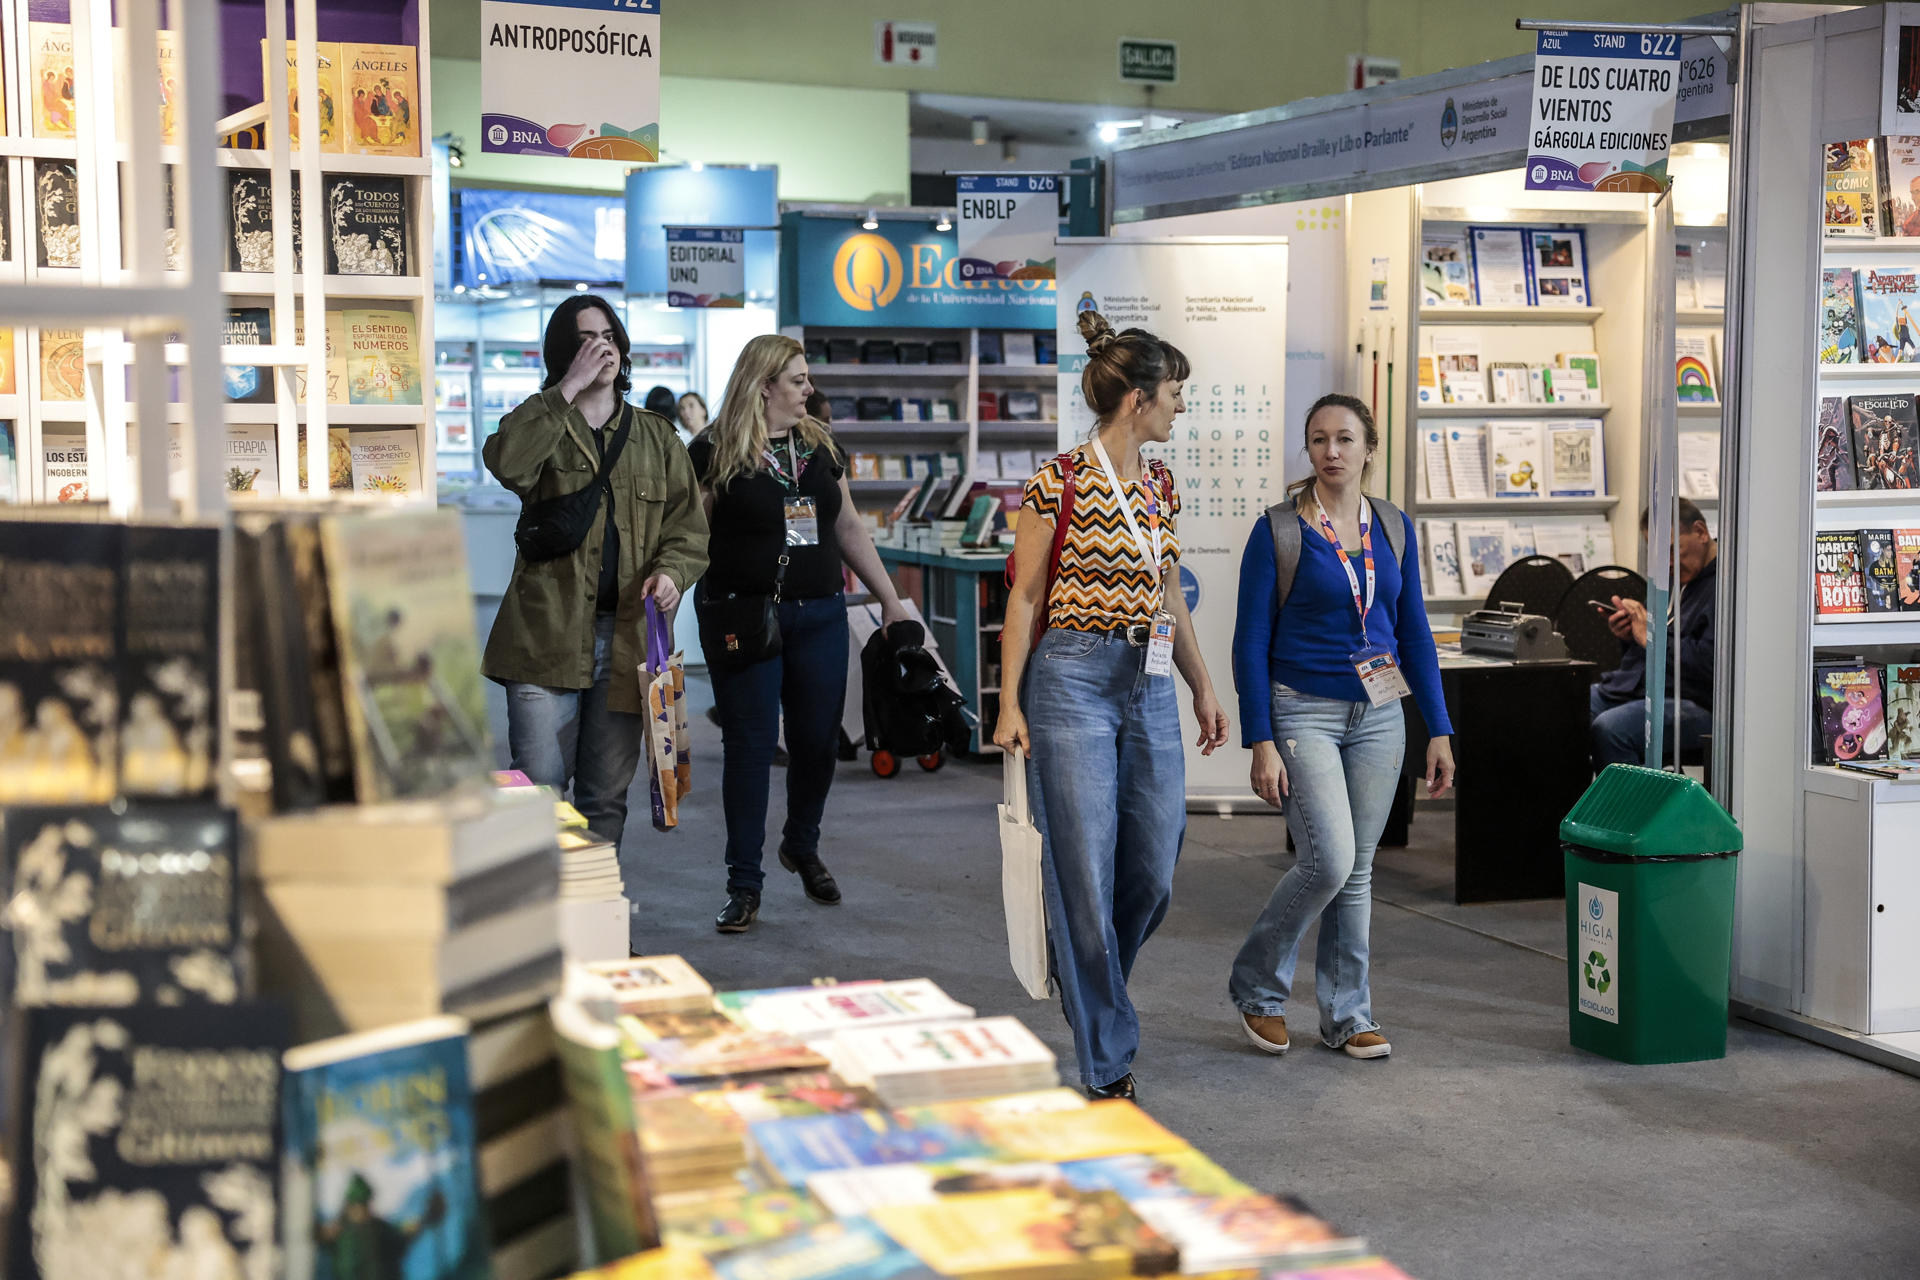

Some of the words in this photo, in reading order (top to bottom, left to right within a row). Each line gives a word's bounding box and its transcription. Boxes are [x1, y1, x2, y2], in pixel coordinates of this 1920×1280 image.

[489, 23, 652, 58] ANTROPOSÓFICA
[1542, 39, 1562, 49] AZUL
[1593, 34, 1625, 49] STAND
[1640, 33, 1675, 56] 622
[352, 58, 408, 72] ÁNGELES
[1541, 65, 1563, 88] DE
[1569, 67, 1600, 90] LOS
[1606, 68, 1671, 92] CUATRO
[1677, 82, 1714, 101] rgentina
[1539, 98, 1613, 123] VIENTOS
[512, 130, 542, 144] BNA
[1461, 125, 1497, 144] Argentina
[1534, 125, 1595, 149] GÁRGOLA
[1600, 132, 1668, 150] EDICIONES
[1263, 144, 1299, 165] Nacional
[1301, 136, 1330, 160] Braille
[1331, 142, 1337, 158] y
[995, 178, 1019, 187] STAND
[1550, 169, 1574, 181] BNA
[355, 189, 399, 201] TODOS
[963, 199, 1016, 219] ENBLP
[355, 212, 399, 224] GRIMM
[670, 246, 736, 263] EDITORIAL
[670, 266, 698, 284] UNQ
[1868, 270, 1916, 285] ADVENTURE
[1878, 281, 1917, 295] TIME
[352, 325, 364, 333] EL
[365, 324, 408, 334] SENTIDO
[353, 338, 409, 351] NÚMEROS
[375, 372, 387, 389] 3
[390, 365, 402, 382] 8
[1190, 384, 1198, 395] F
[1211, 384, 1221, 395] G
[1235, 384, 1245, 395] H
[1864, 399, 1908, 410] ESQUELETO
[1188, 426, 1199, 441] Ñ
[1211, 429, 1222, 441] O
[1235, 429, 1244, 441] P
[1258, 429, 1269, 443] Q
[353, 451, 410, 460] CONOCIMIENTO
[360, 444, 387, 452] TEORÍA
[46, 452, 65, 462] LOS
[1185, 477, 1201, 489] W
[1211, 477, 1221, 489] X
[1234, 477, 1245, 489] Y
[1259, 477, 1267, 489] Z
[1198, 546, 1230, 554] Derechos
[1580, 919, 1613, 941] HIGIA
[1579, 998, 1615, 1016] RECICLADO
